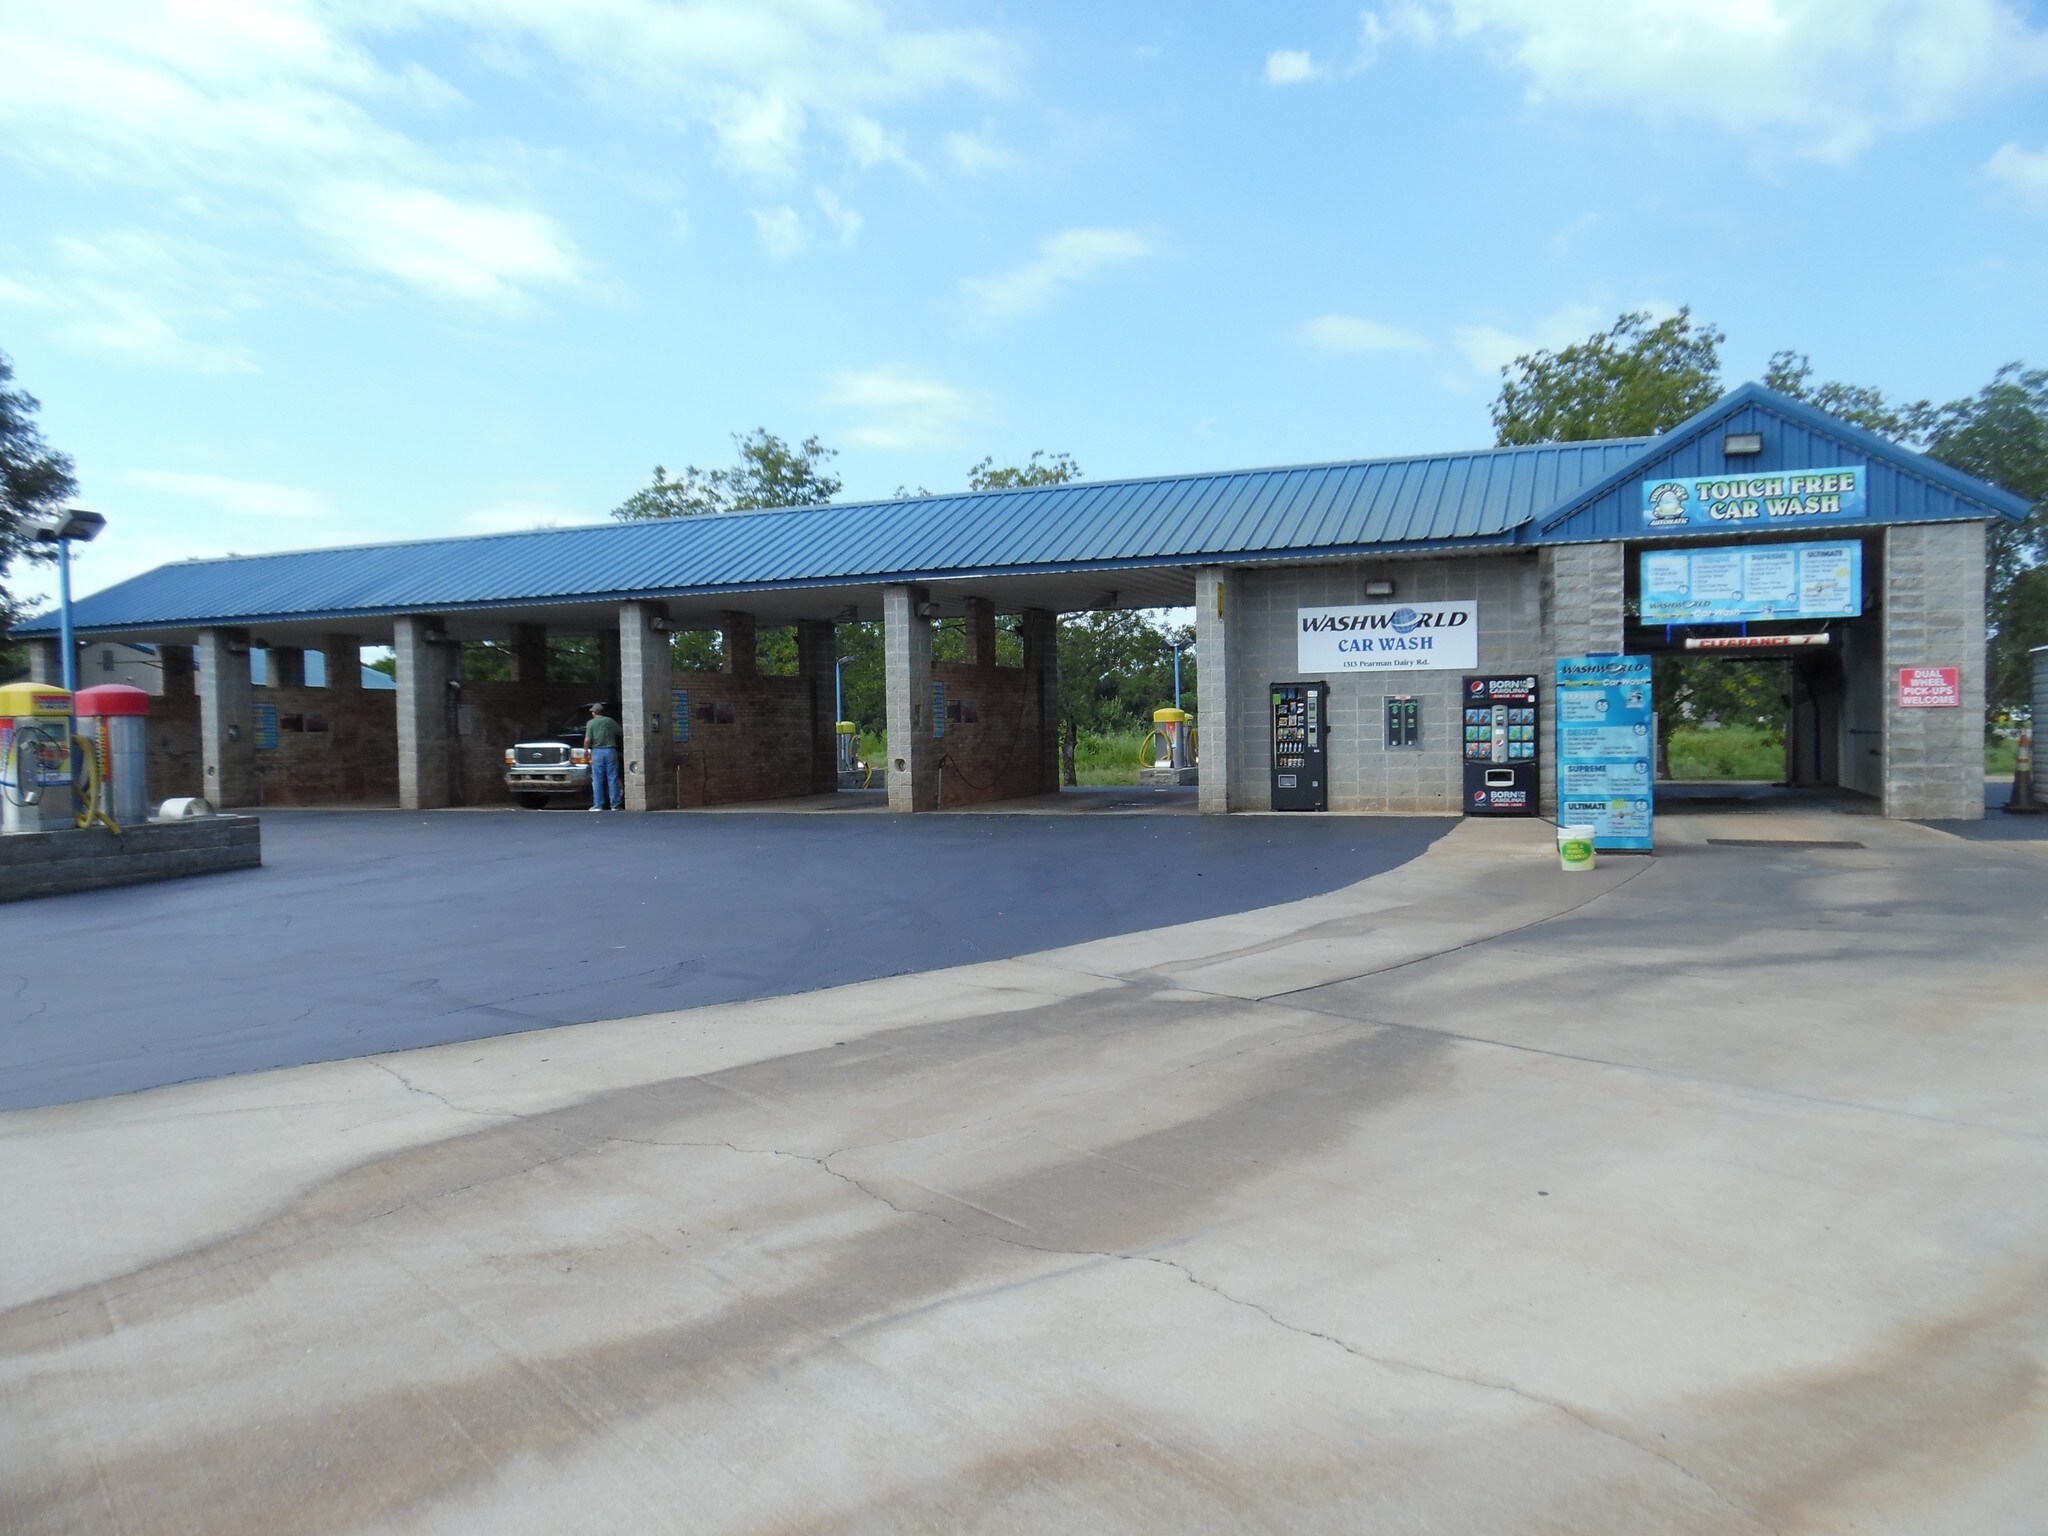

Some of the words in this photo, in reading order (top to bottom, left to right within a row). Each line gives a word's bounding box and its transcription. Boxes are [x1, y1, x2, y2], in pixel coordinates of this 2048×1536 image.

[1696, 476, 1784, 501] TOUCH
[1789, 472, 1856, 494] FREE
[1709, 500, 1760, 520] CAR
[1764, 495, 1840, 517] WASH
[1648, 517, 1690, 526] AUTOMATIC
[1807, 549, 1843, 558] ULTIMATE
[1302, 607, 1469, 634] WASHWORLD
[1338, 638, 1374, 653] CAR
[1378, 636, 1433, 651] WASH
[1700, 636, 1792, 648] CLEARANCE
[1394, 659, 1414, 667] Dairy
[1416, 658, 1430, 666] Rd.
[1914, 670, 1943, 678] DUAL
[1489, 680, 1520, 689] BORN
[1602, 678, 1619, 686] Car
[1621, 677, 1646, 686] Wash
[1910, 678, 1947, 687] WHEEL
[1903, 686, 1953, 696] PICK-UPS
[1902, 695, 1956, 704] WELCOME
[1568, 765, 1607, 773] SUPREME
[1490, 790, 1517, 798] BORN
